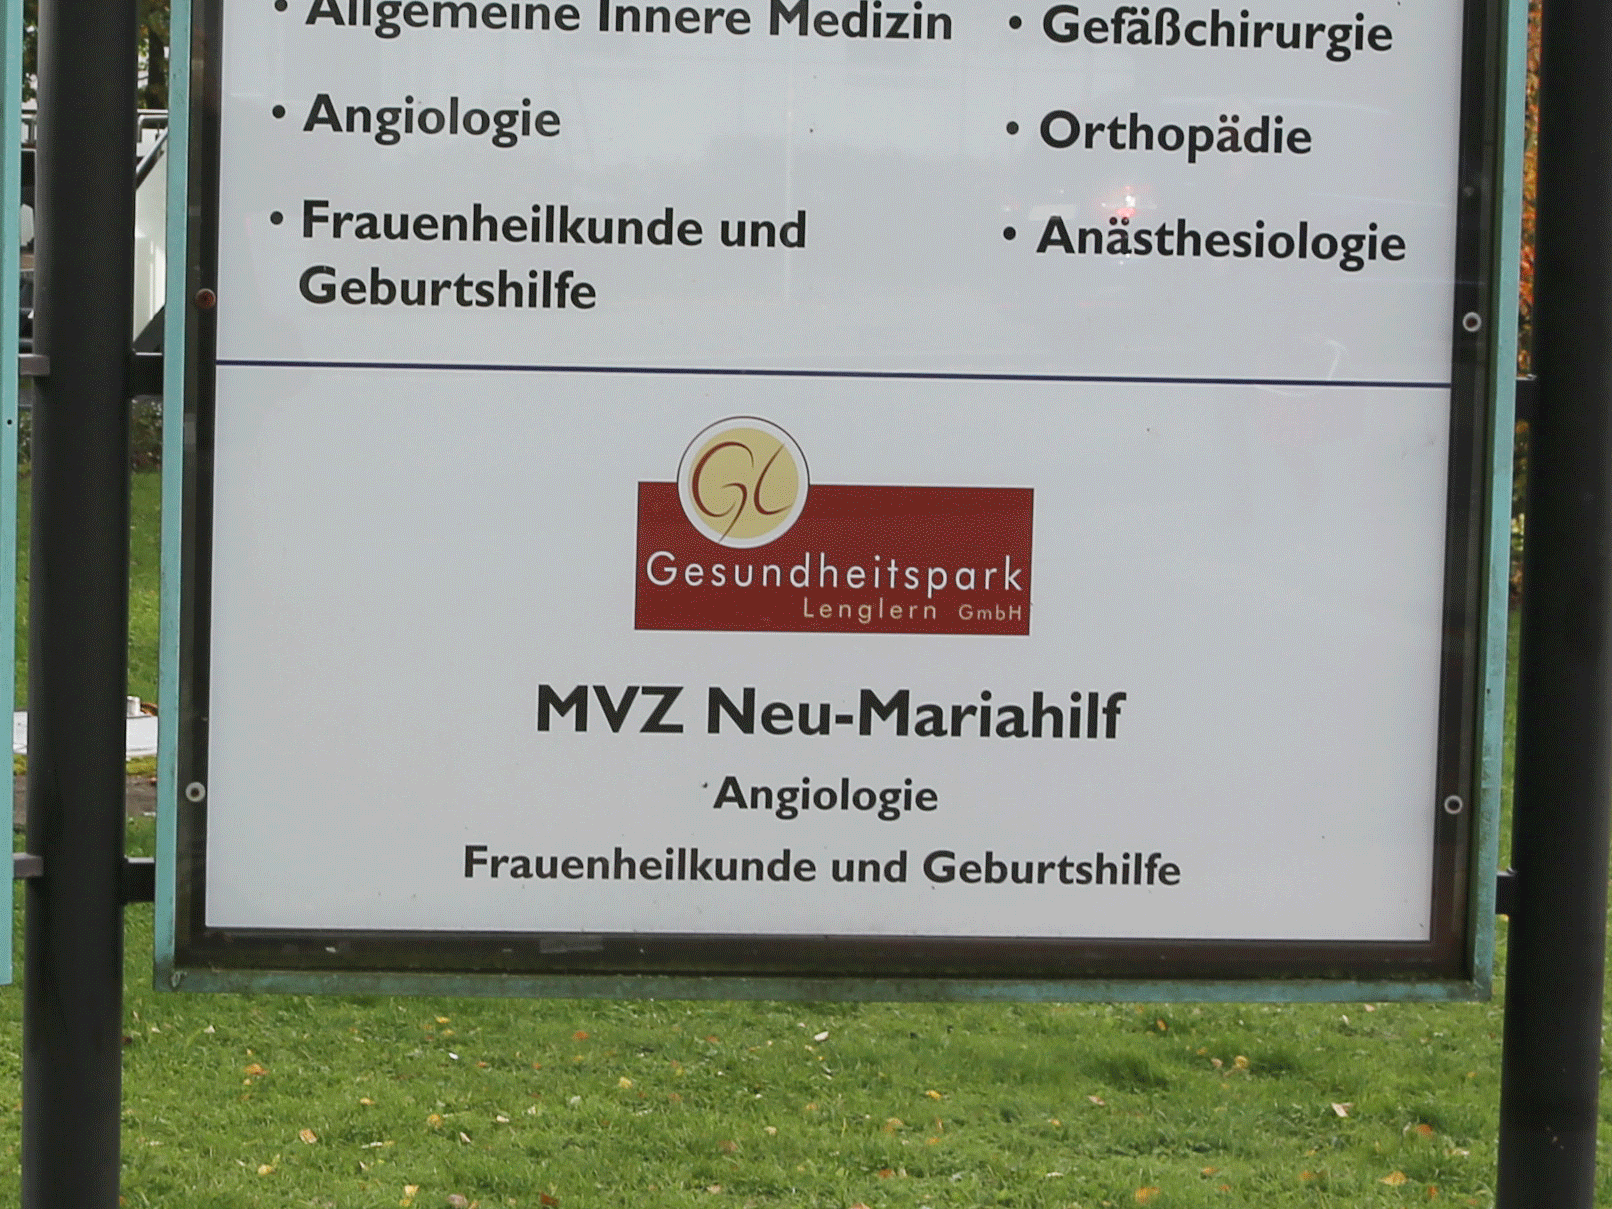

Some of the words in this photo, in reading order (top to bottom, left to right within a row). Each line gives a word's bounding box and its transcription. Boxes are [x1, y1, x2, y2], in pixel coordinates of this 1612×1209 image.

[1042, 4, 1393, 62] Gefäßchirurgie
[303, 93, 562, 147] Angiologie
[1040, 109, 1312, 164] Orthopädie
[302, 199, 704, 247] Frauenheilkunde
[719, 210, 807, 249] und
[1036, 215, 1406, 272] Anästhesiologie
[299, 265, 598, 310] Geburtshilfe
[646, 550, 1023, 599] Gesundheitspark
[803, 596, 938, 624] Lenglern
[958, 603, 1022, 622] GmbH
[536, 684, 684, 734] MVZ
[706, 686, 1127, 739] Neu-Mariahilf
[713, 776, 939, 821] Angiologie
[463, 845, 817, 883] Frauenheilkunde
[831, 850, 907, 884] und
[923, 849, 1181, 886] Geburtshilfe
